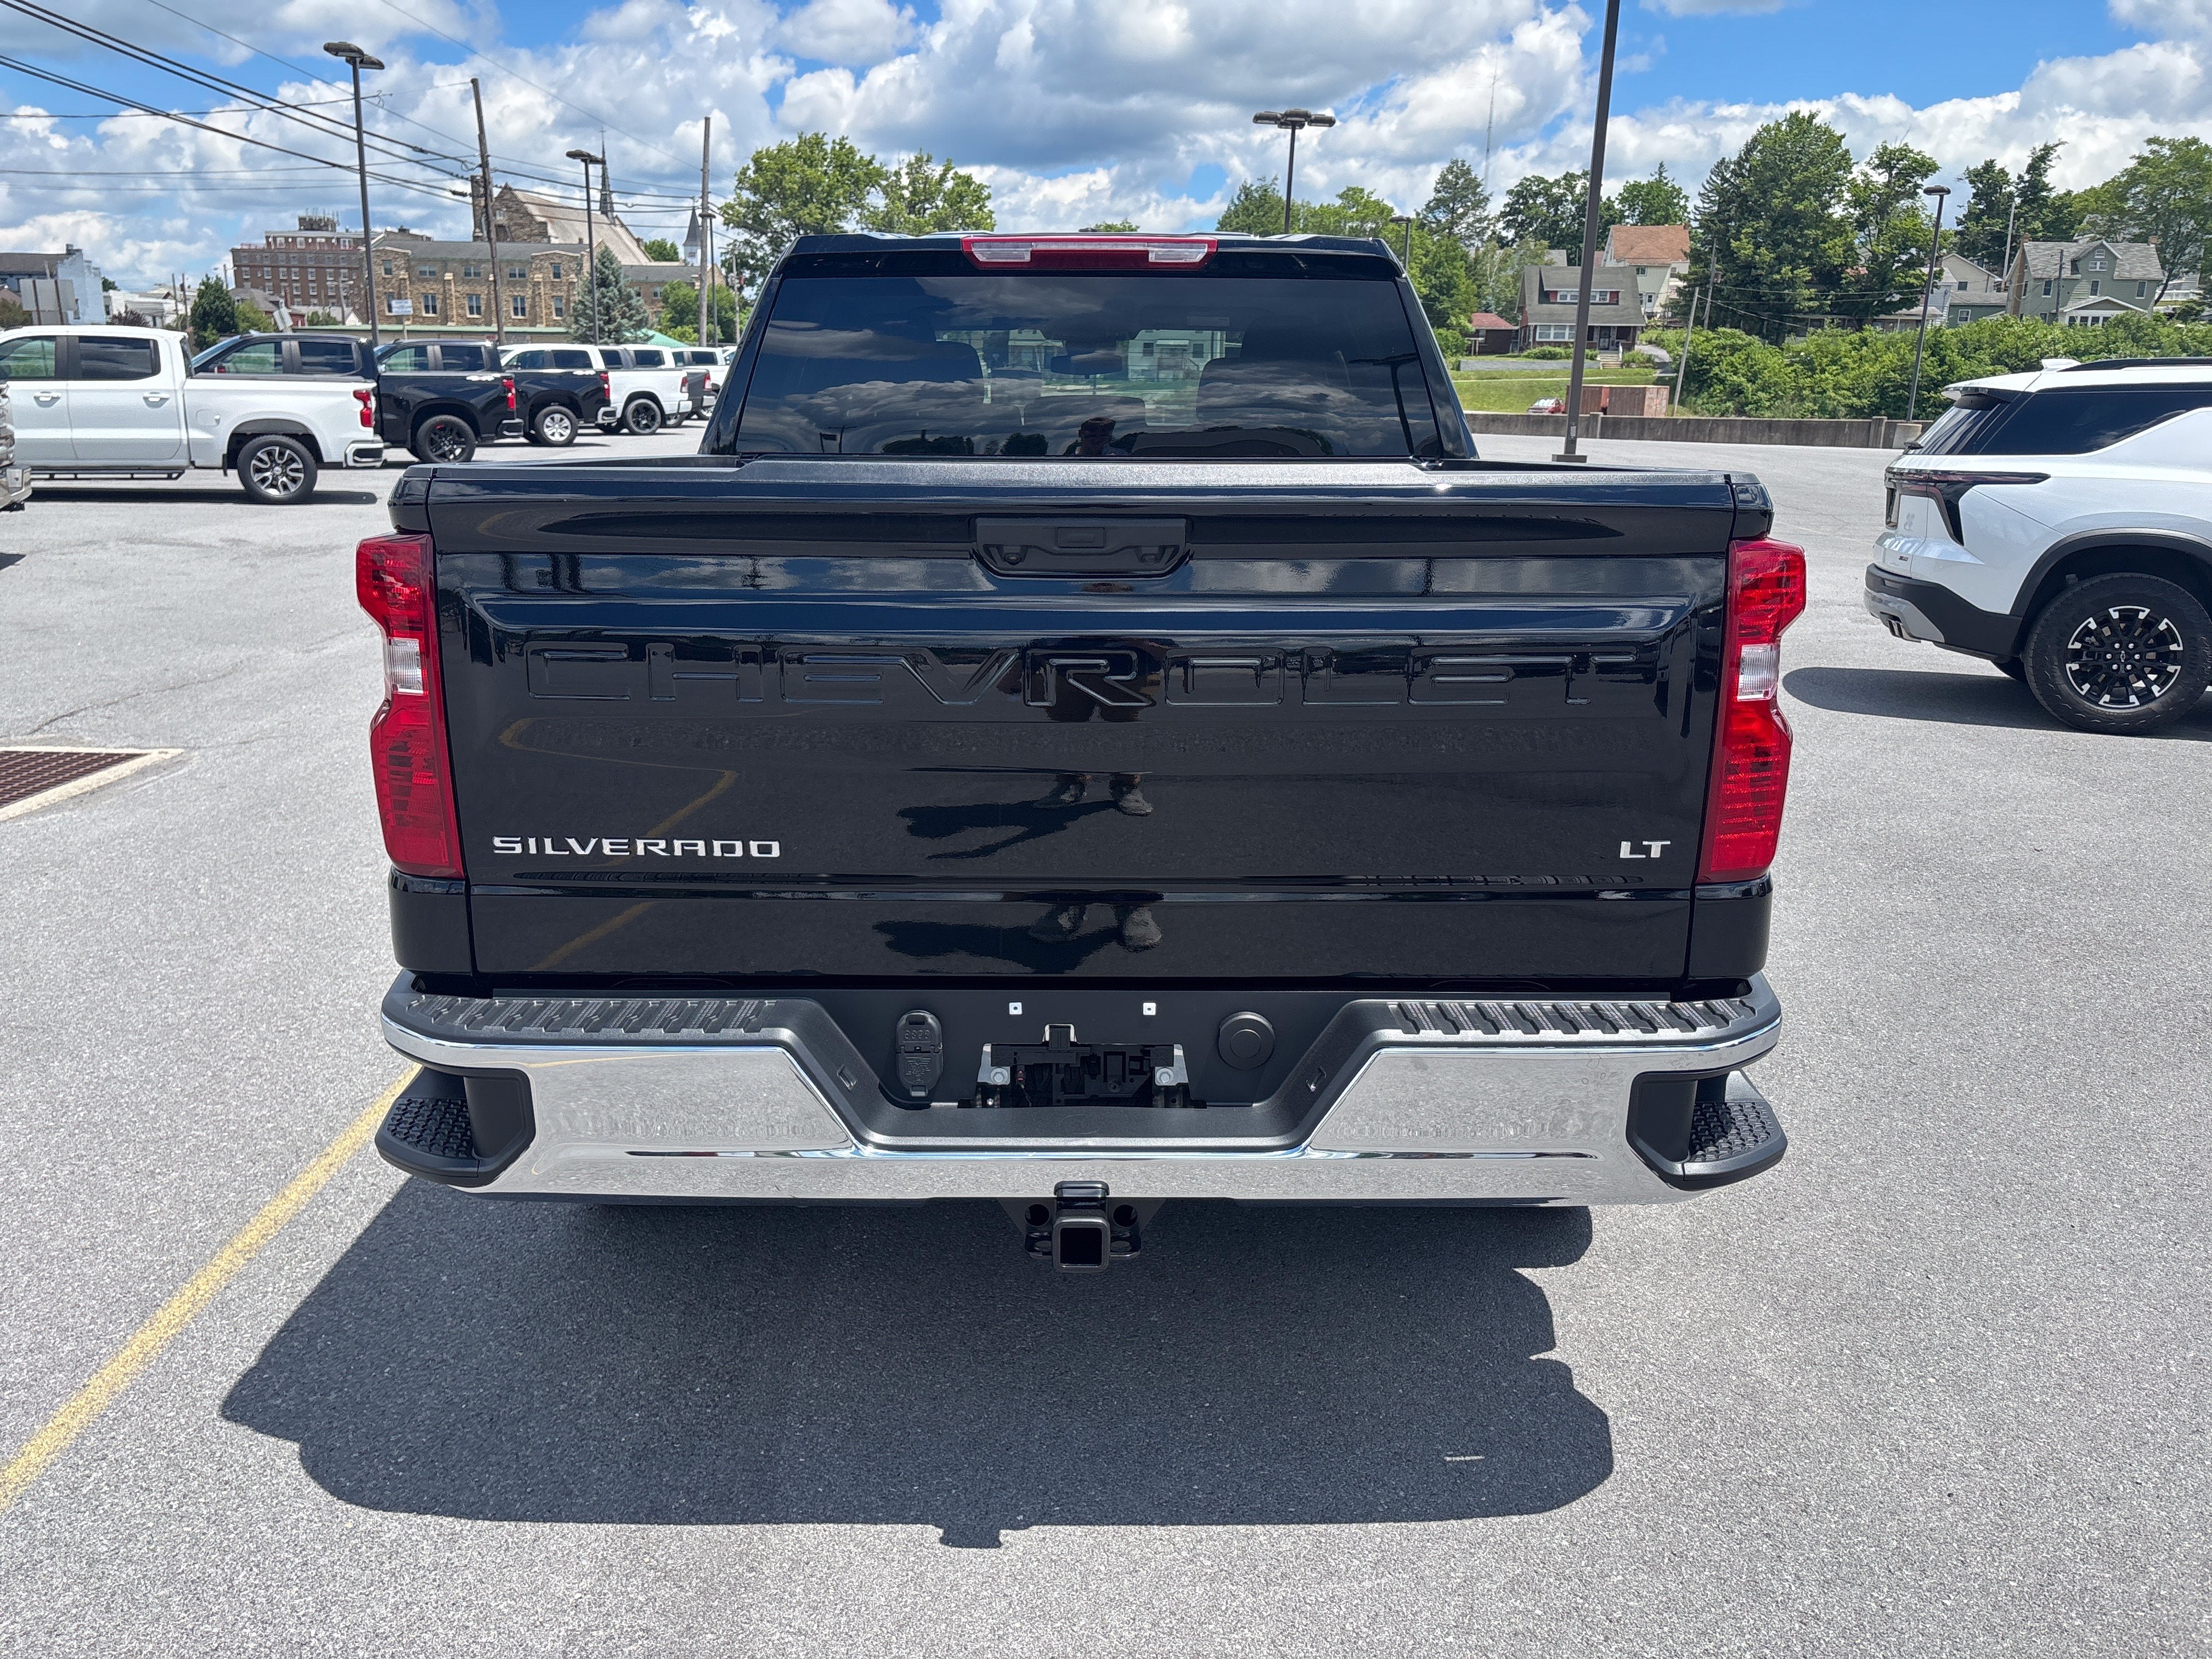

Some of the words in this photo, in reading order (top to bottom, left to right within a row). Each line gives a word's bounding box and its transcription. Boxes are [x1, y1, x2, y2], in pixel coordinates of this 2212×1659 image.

[525, 641, 1639, 707] CHEVROLET
[493, 836, 781, 857] SILVERADO
[1620, 840, 1671, 859] LT
